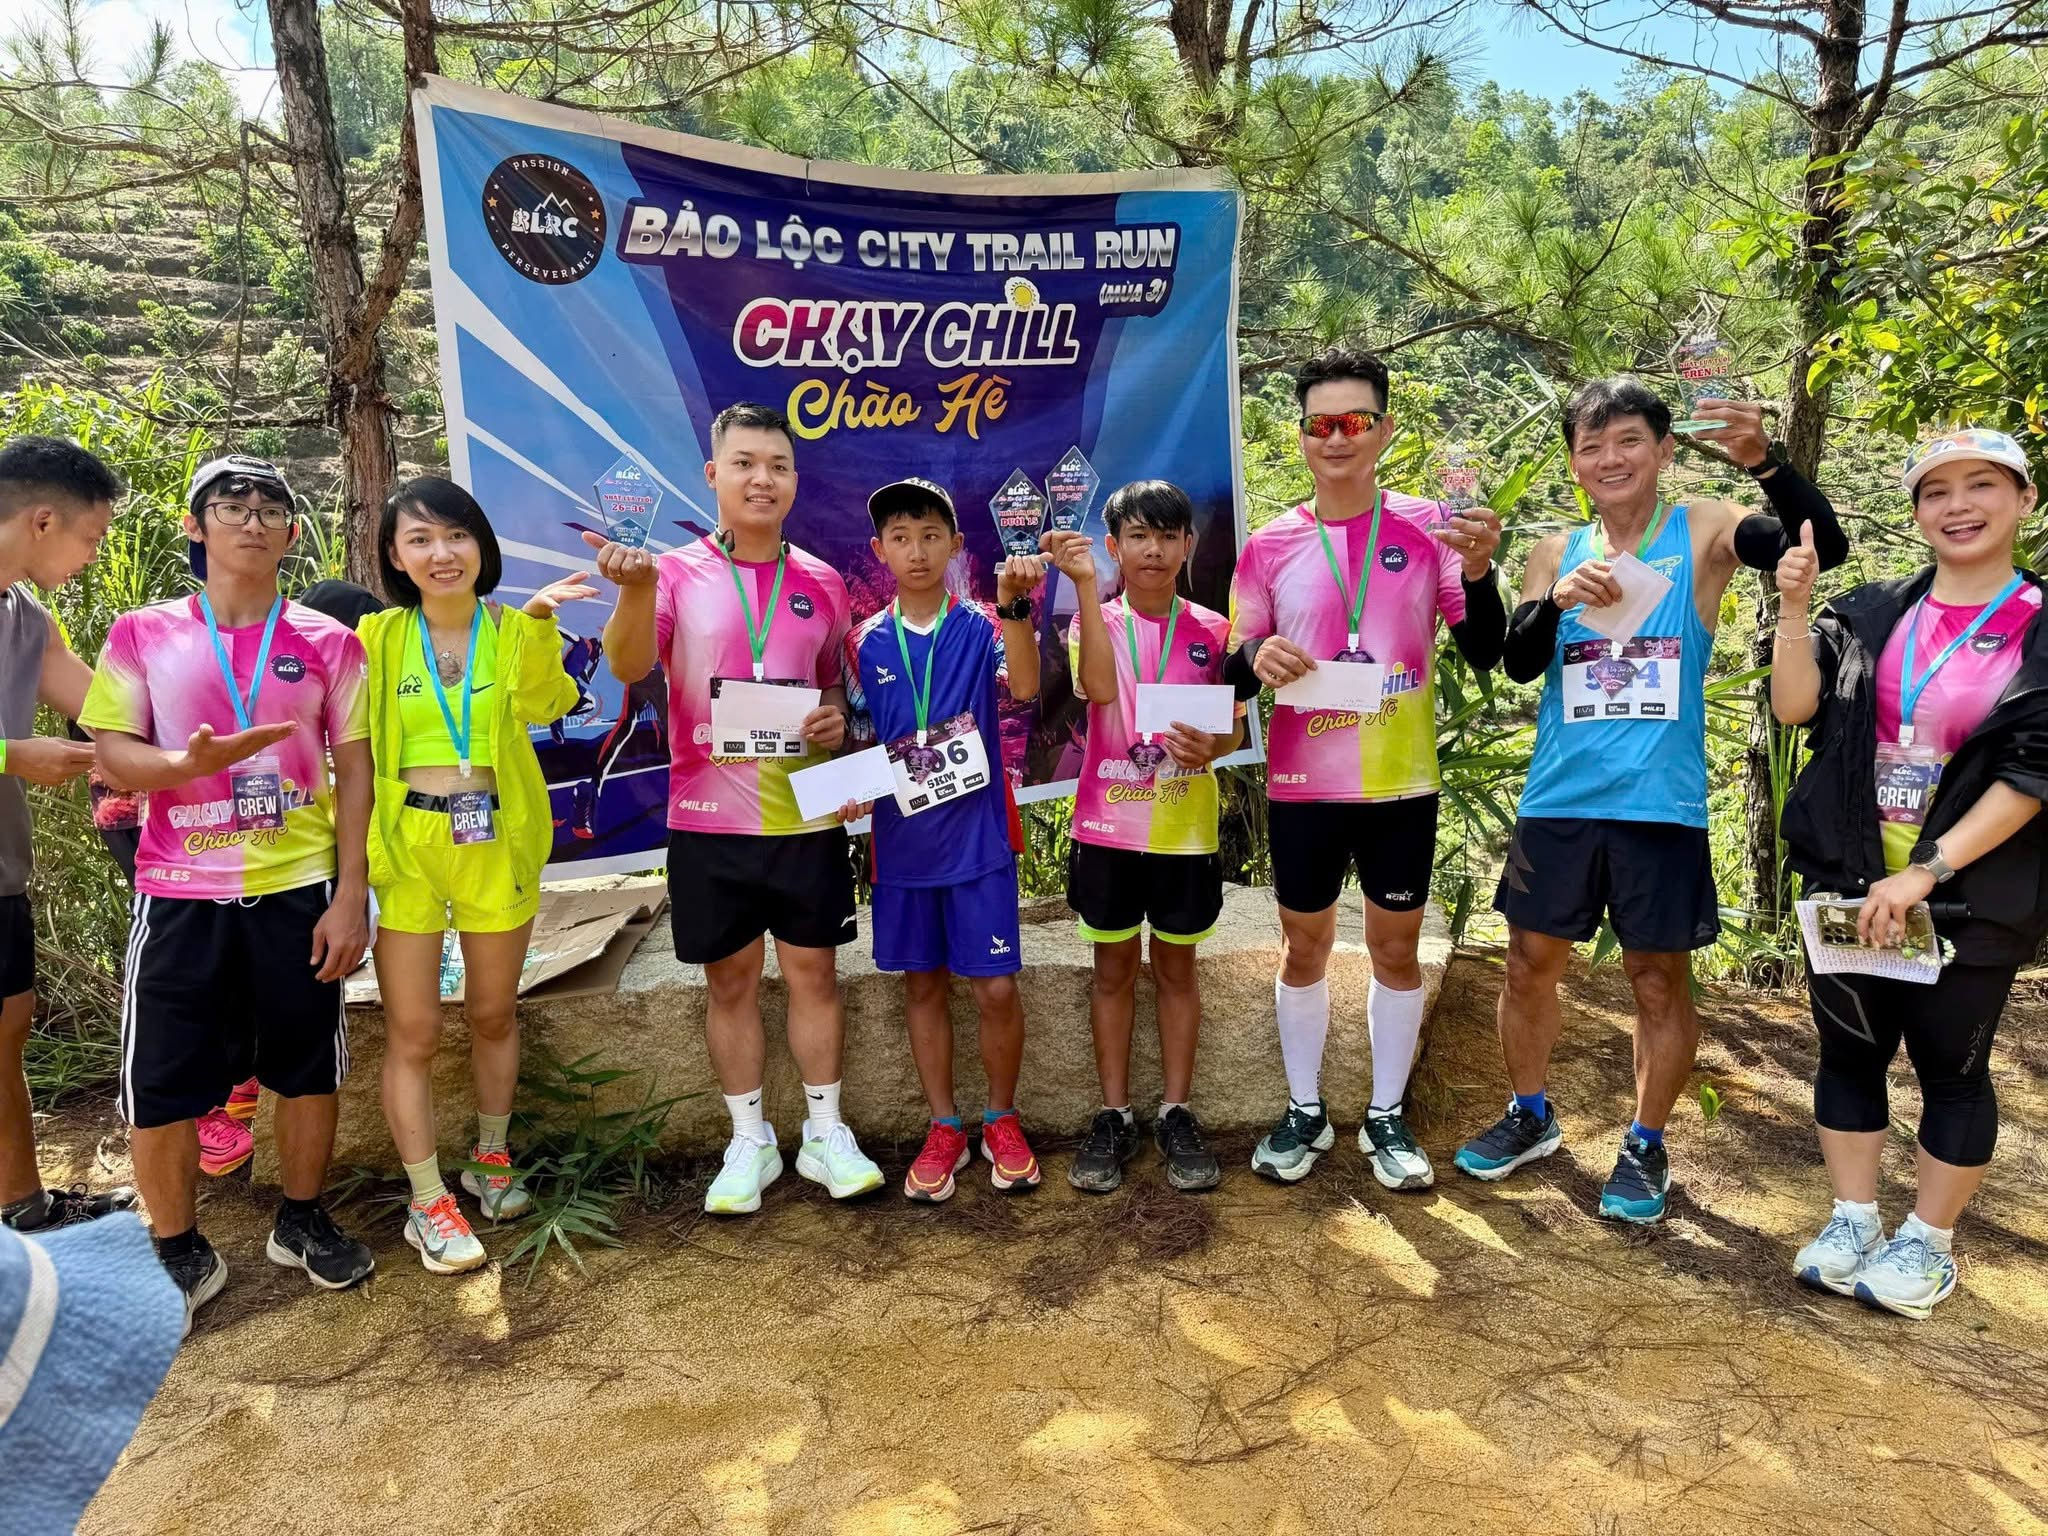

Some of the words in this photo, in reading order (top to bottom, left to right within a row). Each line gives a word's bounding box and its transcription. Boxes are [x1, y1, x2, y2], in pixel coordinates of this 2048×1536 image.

[512, 159, 570, 176] PASSION
[511, 208, 579, 238] BLRC
[624, 200, 741, 259] BẢO
[755, 214, 844, 270] LỘC
[858, 230, 955, 271] CITY
[966, 232, 1084, 272] TRAIL
[1095, 228, 1176, 269] RUN
[501, 243, 595, 279] PERSEVERANCE
[733, 297, 925, 374] CHẠY
[925, 298, 1080, 368] CHILL
[787, 378, 922, 440] Chào
[934, 372, 1013, 440] Hè
[398, 684, 422, 694] LRC
[1382, 669, 1419, 697] HILL
[750, 730, 781, 740] 5KM
[927, 771, 957, 789] 5KM
[238, 795, 277, 817] CREW
[1876, 786, 1922, 809] CREW
[454, 809, 489, 831] CREW
